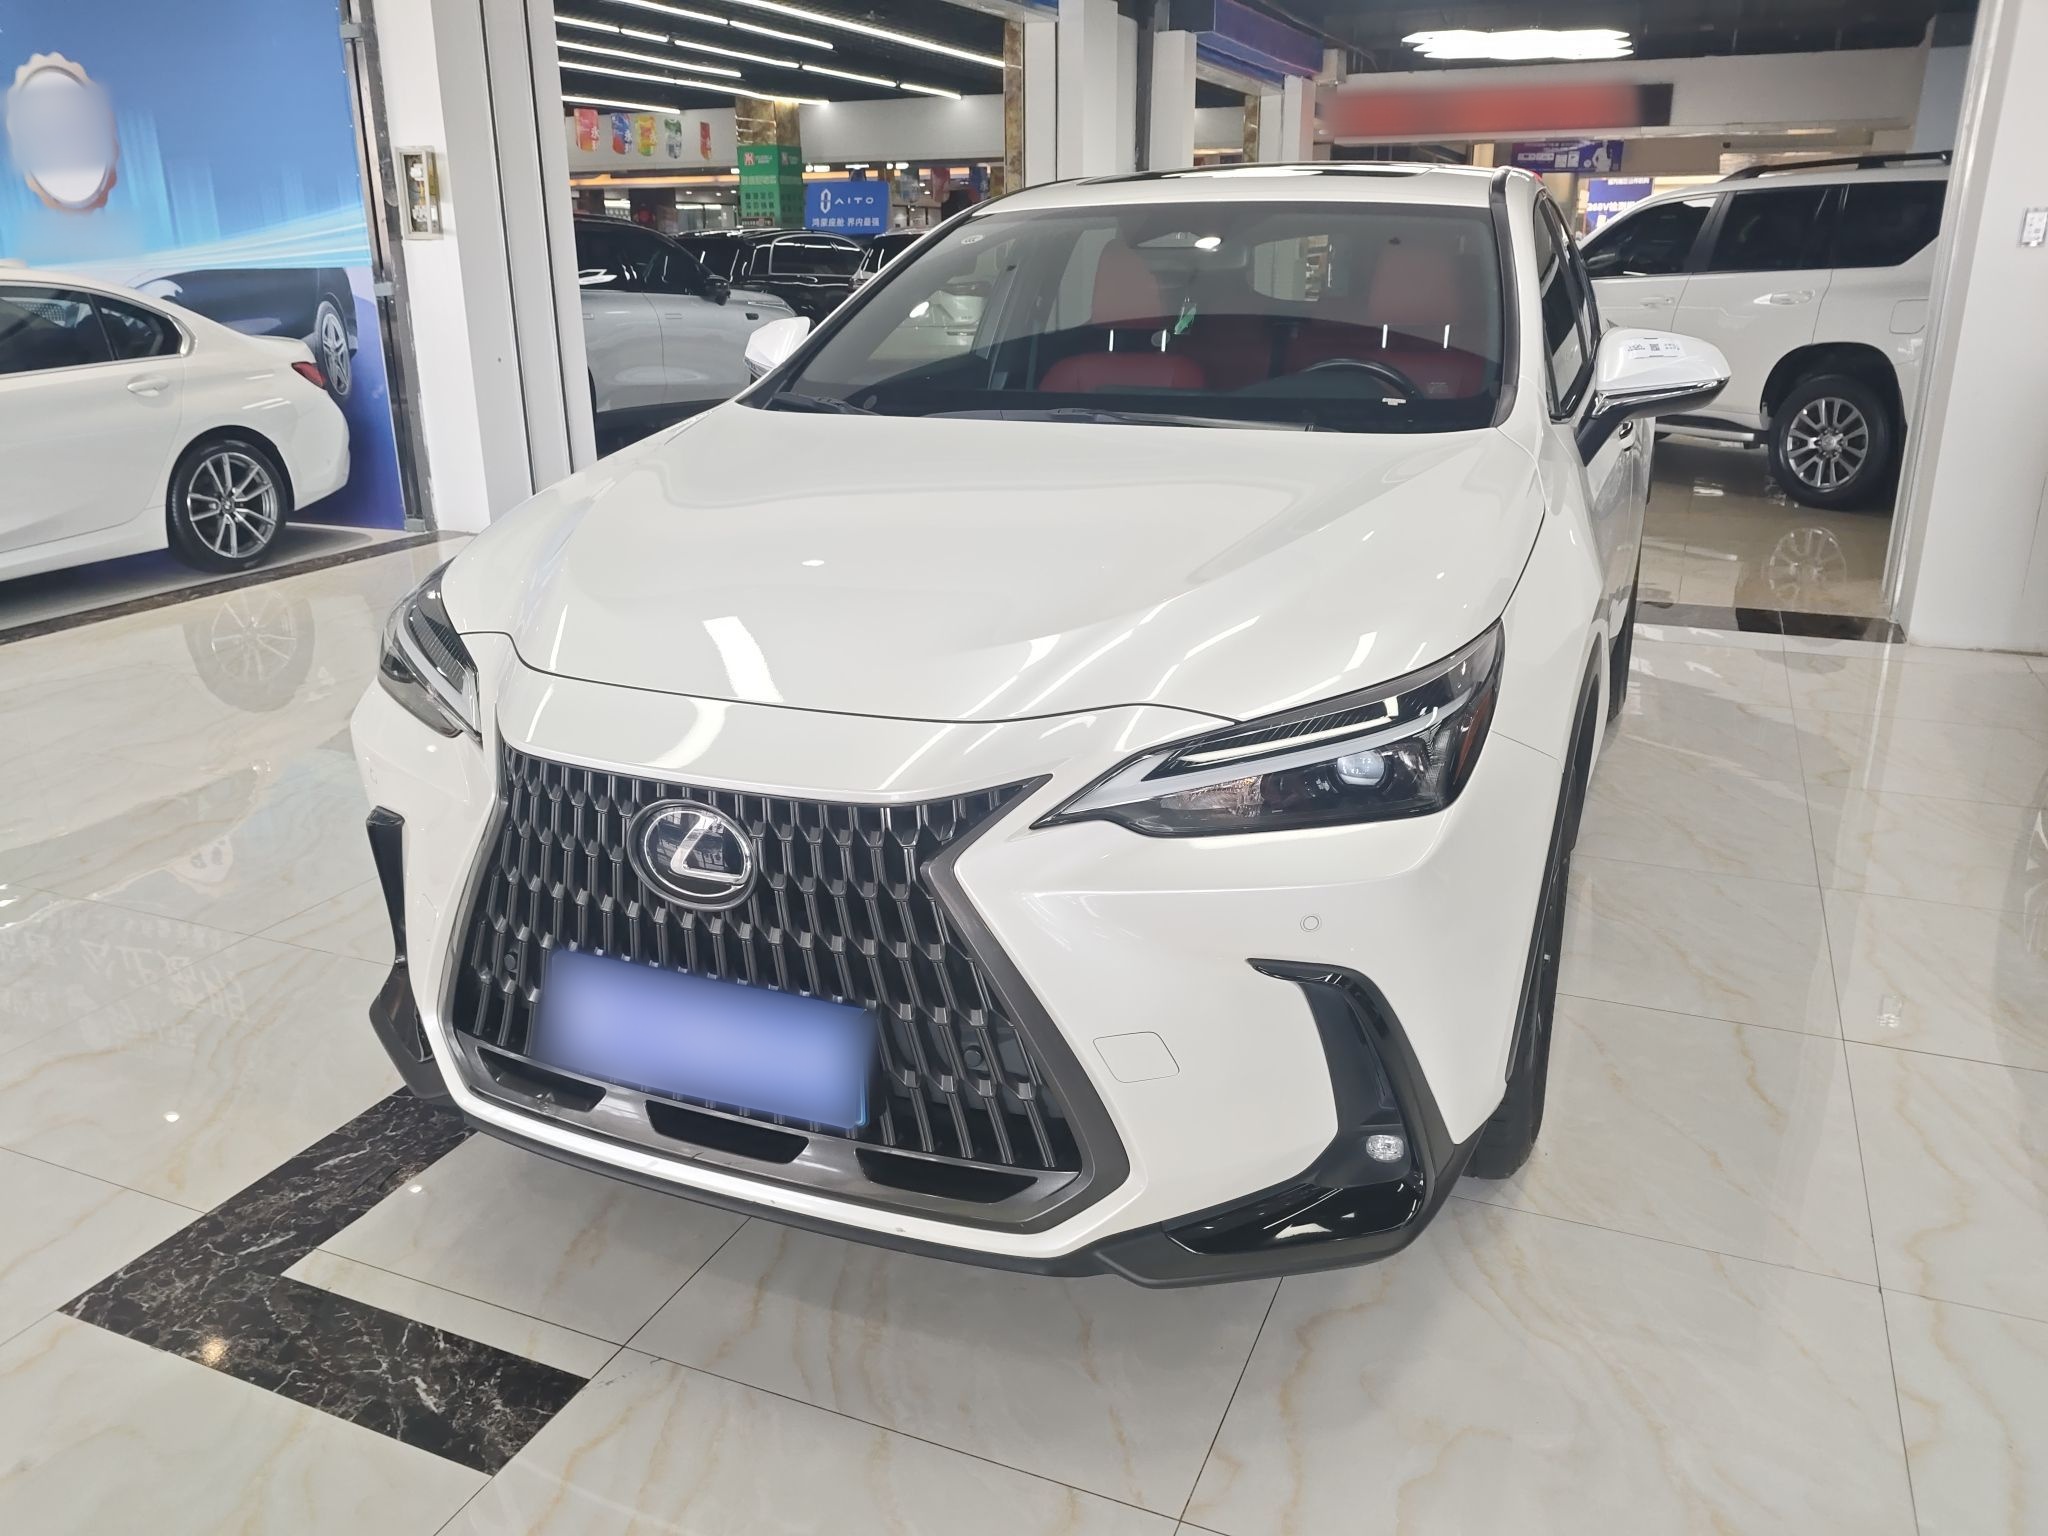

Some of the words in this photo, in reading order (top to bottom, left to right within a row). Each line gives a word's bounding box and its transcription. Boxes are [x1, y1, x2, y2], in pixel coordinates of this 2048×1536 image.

[834, 197, 874, 205] AITO
[847, 217, 880, 228] 界内最强
